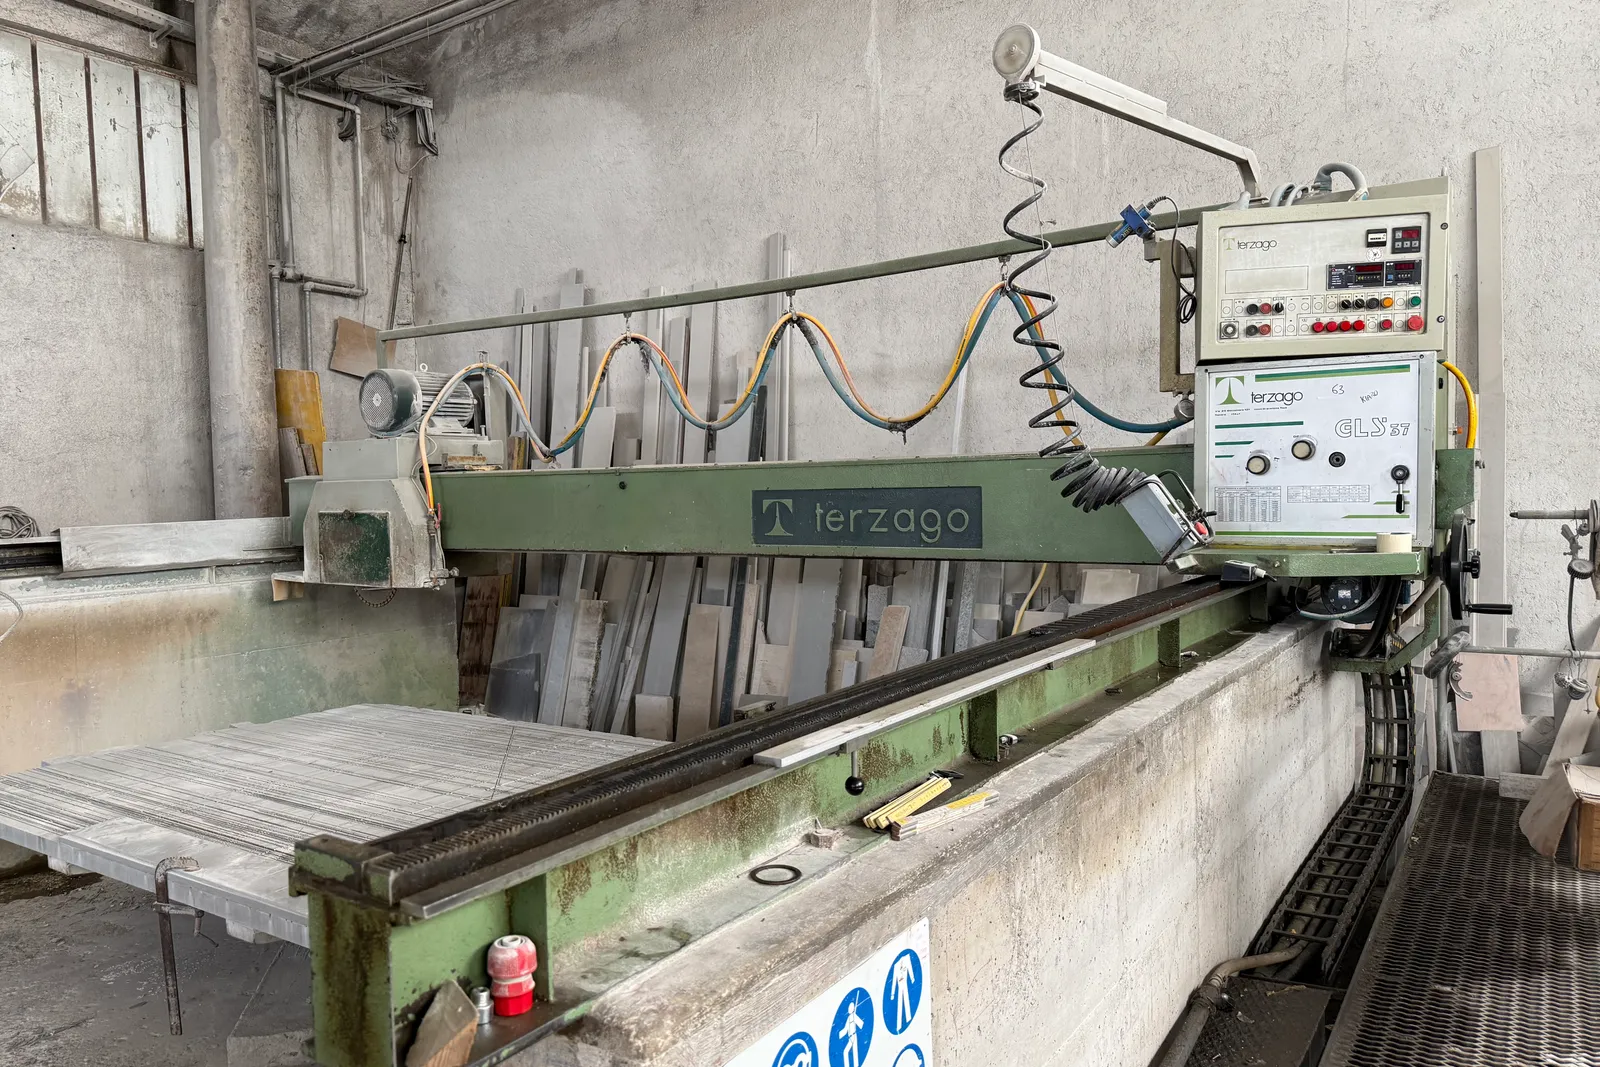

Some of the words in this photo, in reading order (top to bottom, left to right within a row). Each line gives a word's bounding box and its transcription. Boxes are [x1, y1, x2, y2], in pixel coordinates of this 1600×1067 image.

[1237, 240, 1278, 252] terzago
[1331, 383, 1345, 395] 63
[1250, 391, 1304, 406] terzago
[815, 502, 970, 544] terzago
